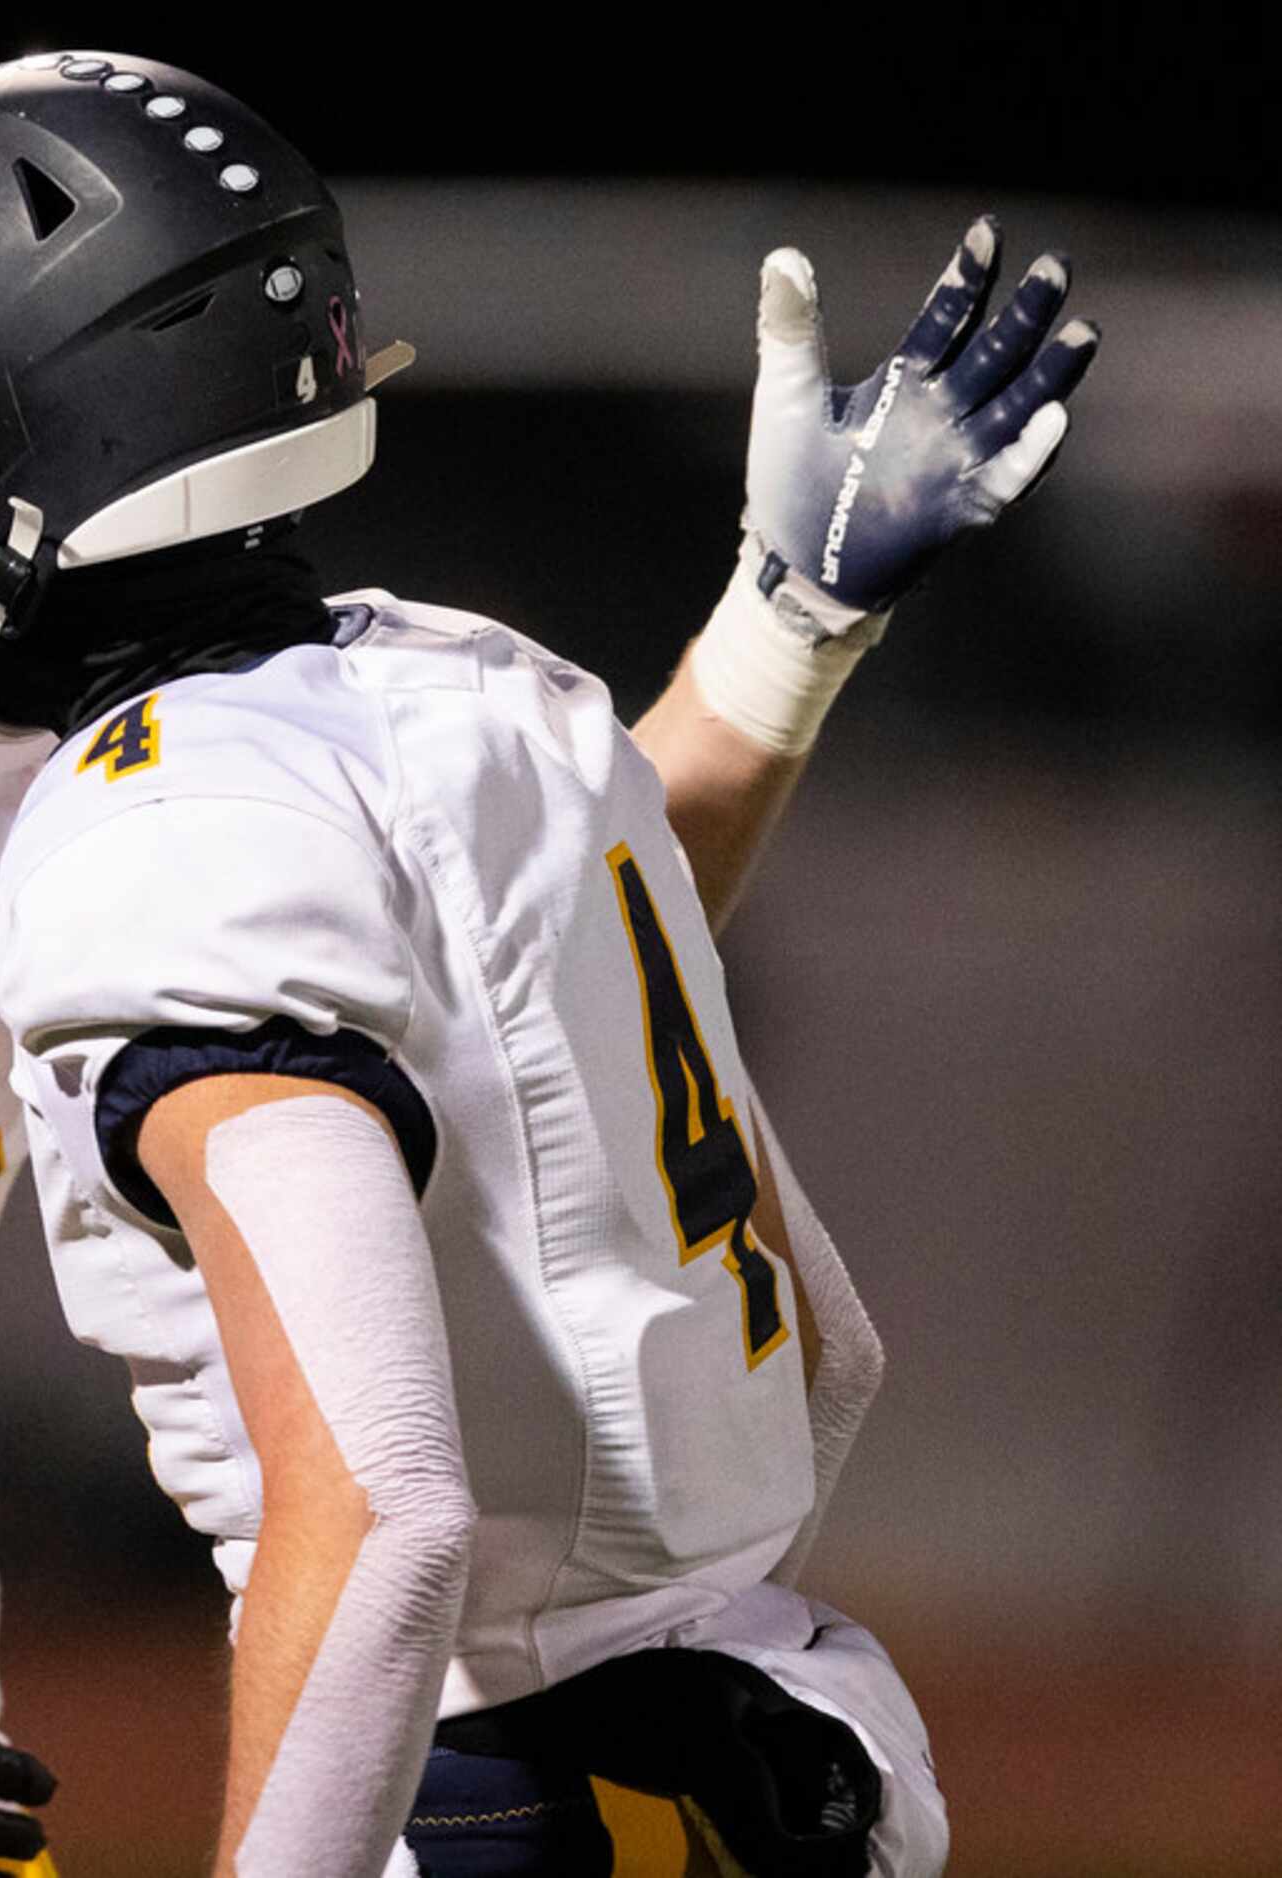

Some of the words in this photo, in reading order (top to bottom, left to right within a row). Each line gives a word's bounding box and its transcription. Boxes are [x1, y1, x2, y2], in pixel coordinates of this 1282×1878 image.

[296, 356, 317, 404] 4
[860, 355, 905, 450] UNDER
[821, 453, 865, 585] ARMOUR
[74, 690, 161, 785] 4
[605, 840, 790, 1373] 4
